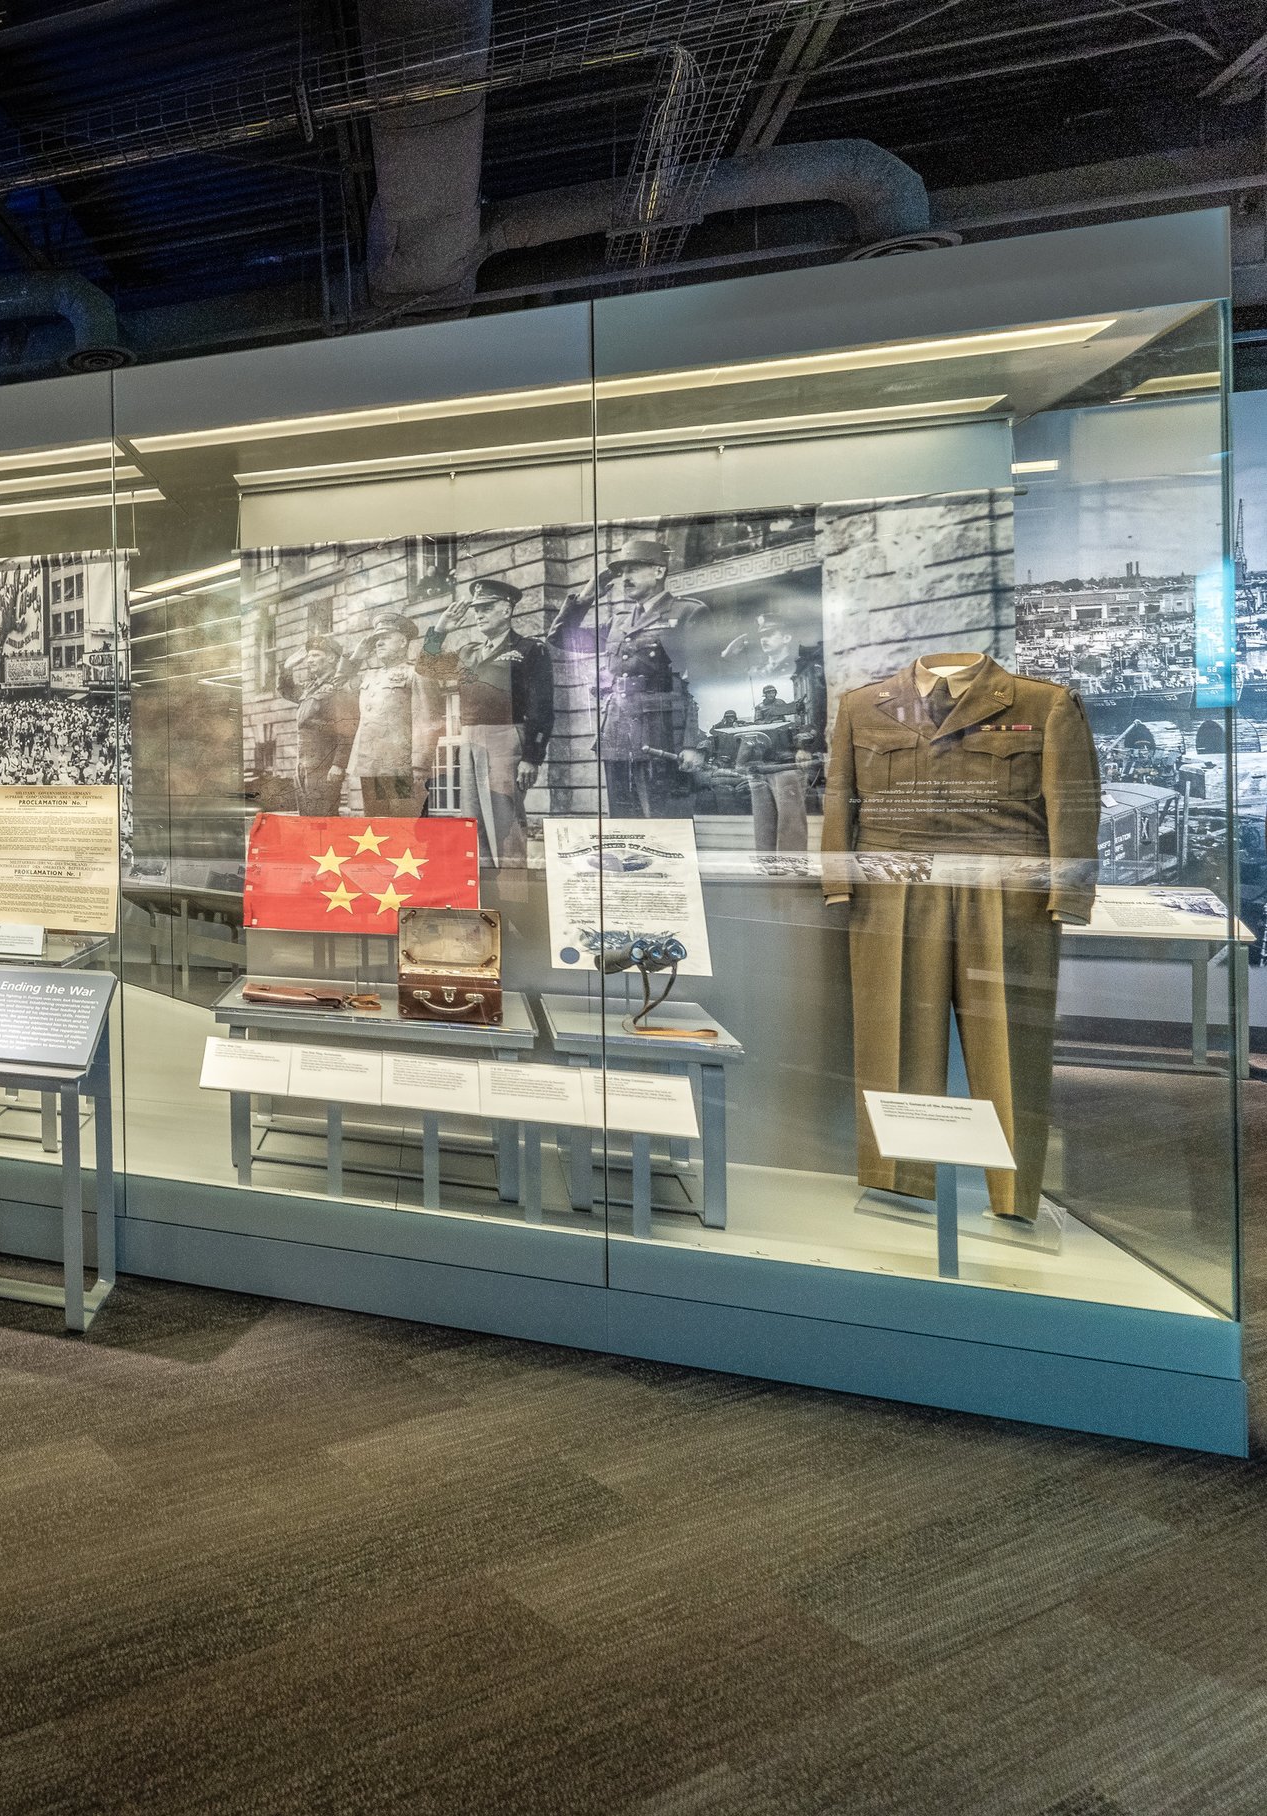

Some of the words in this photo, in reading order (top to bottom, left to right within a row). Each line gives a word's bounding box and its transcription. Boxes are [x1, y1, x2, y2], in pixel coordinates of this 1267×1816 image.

[0, 980, 42, 994] Ending
[45, 984, 66, 994] the
[70, 986, 96, 996] War
